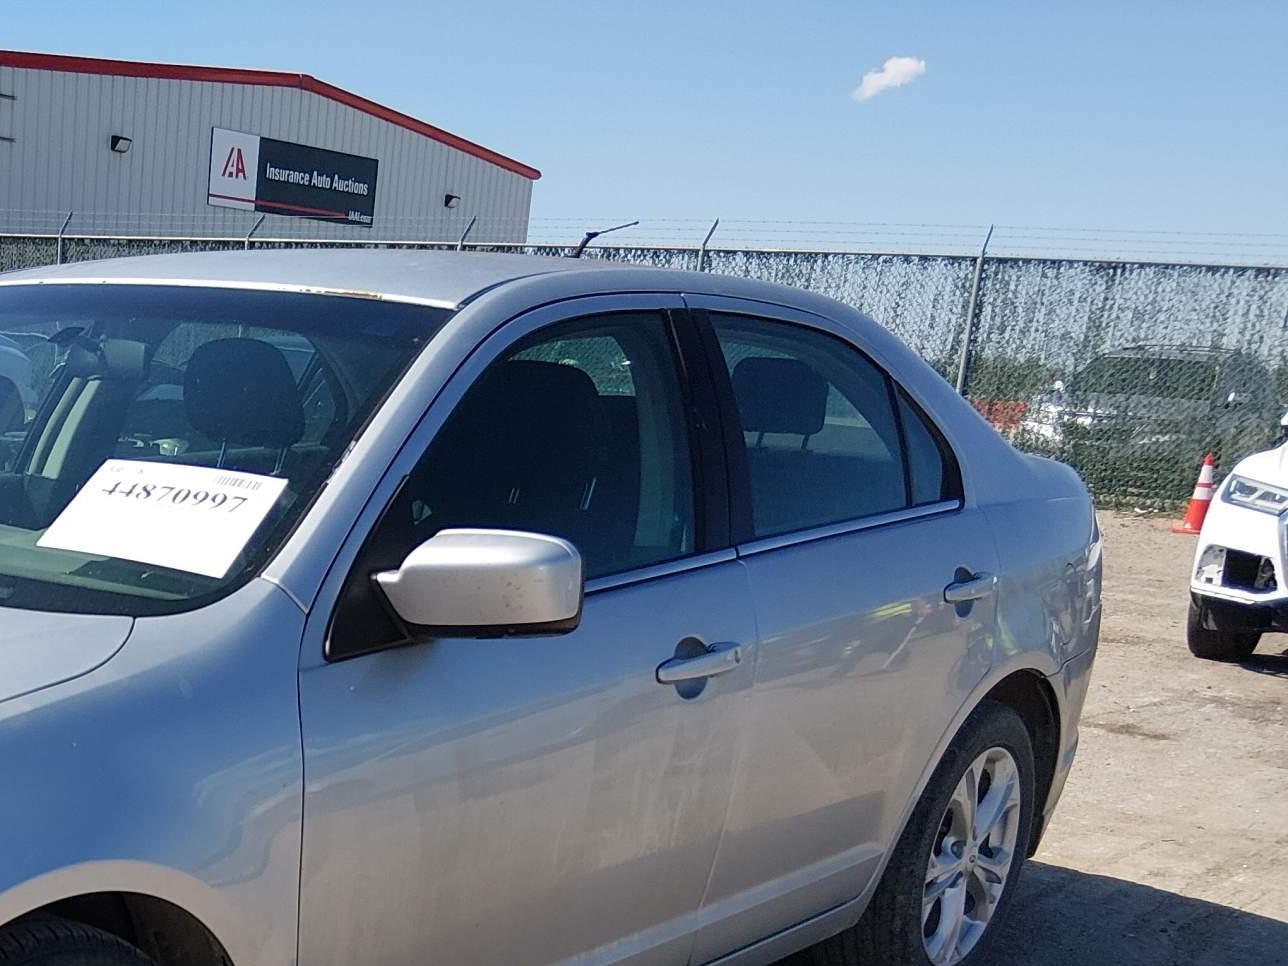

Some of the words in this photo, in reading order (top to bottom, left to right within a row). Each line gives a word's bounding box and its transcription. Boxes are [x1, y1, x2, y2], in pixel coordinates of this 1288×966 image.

[265, 162, 310, 186] Insurance
[311, 170, 331, 190] Auto
[332, 174, 369, 196] Auctions
[101, 480, 248, 513] 44870997
